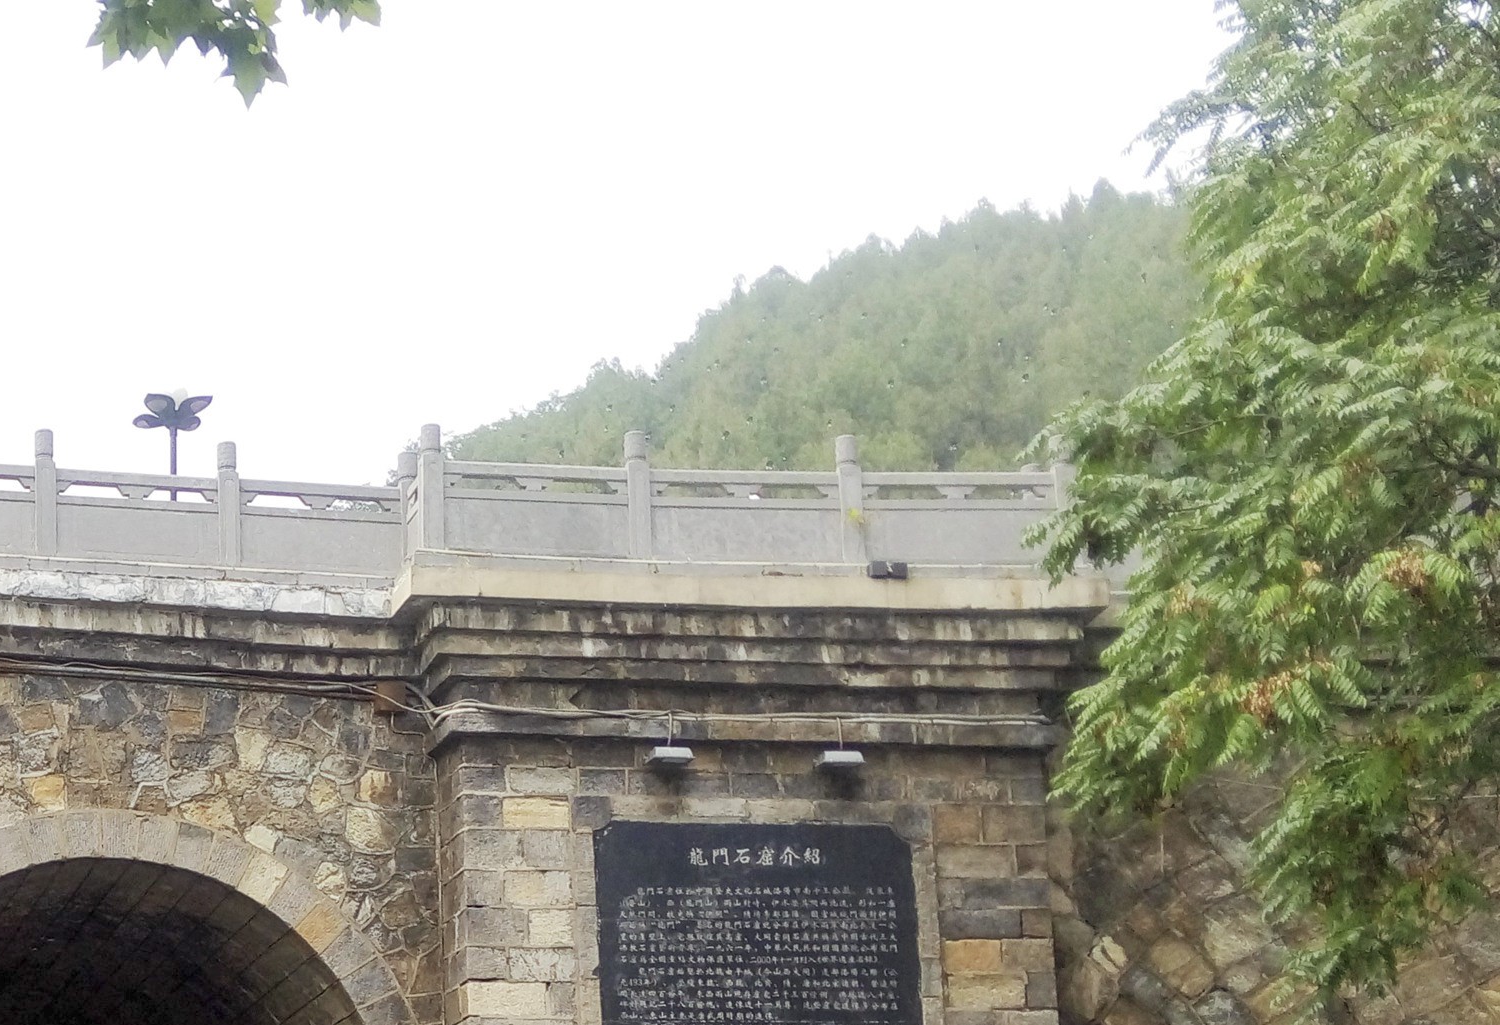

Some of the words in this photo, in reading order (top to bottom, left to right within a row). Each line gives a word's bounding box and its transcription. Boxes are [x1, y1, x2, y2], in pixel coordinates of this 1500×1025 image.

[690, 847, 821, 866] 龍門石窟介紹
